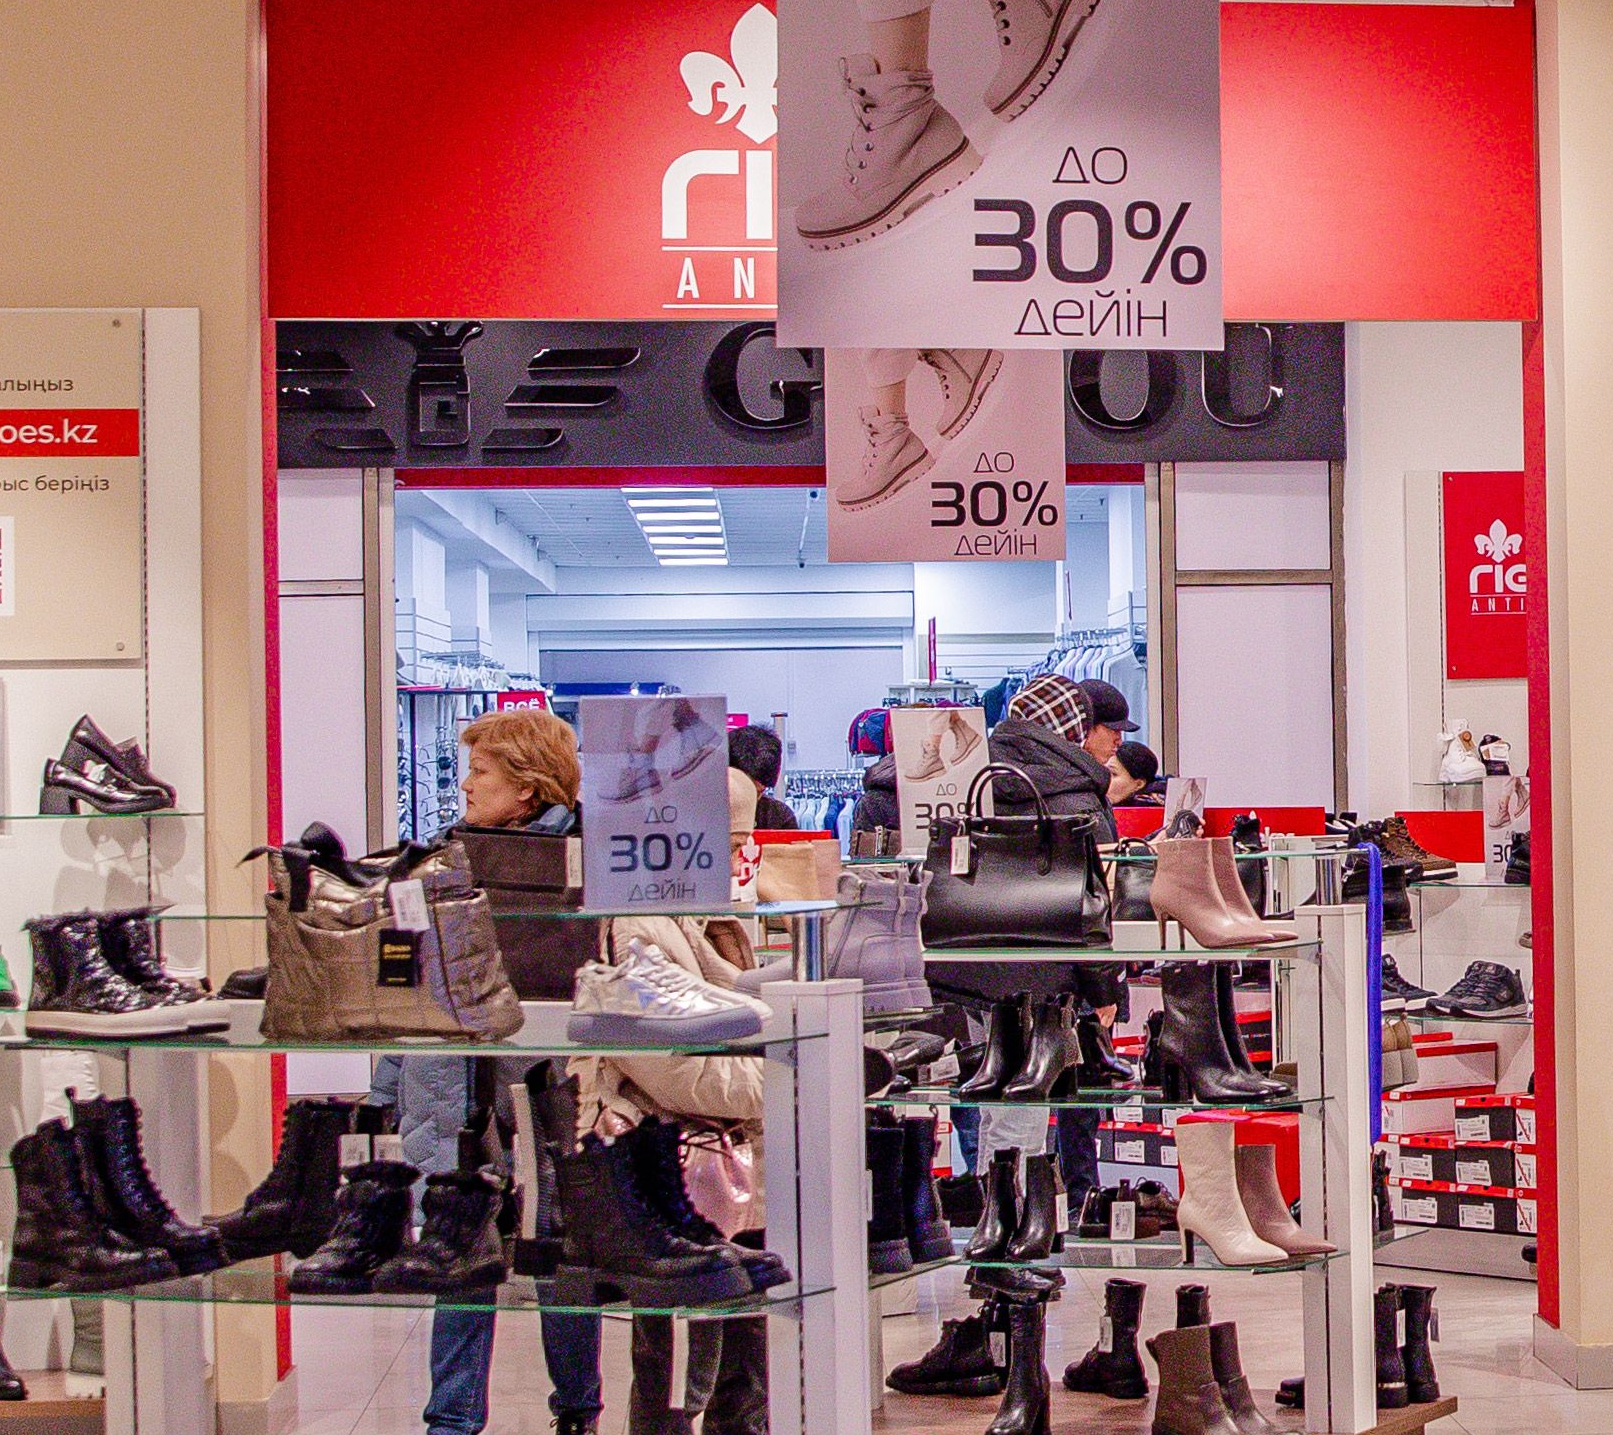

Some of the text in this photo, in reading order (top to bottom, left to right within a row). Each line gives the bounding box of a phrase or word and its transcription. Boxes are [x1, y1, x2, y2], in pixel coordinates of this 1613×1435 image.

[971, 198, 1209, 286] 30%
[1013, 288, 1168, 338] дейін
[35, 474, 111, 496] беріңіз
[929, 479, 1060, 529] 30%
[953, 528, 1038, 557] дейін
[609, 831, 714, 874] 30%
[627, 878, 697, 903] дейін
